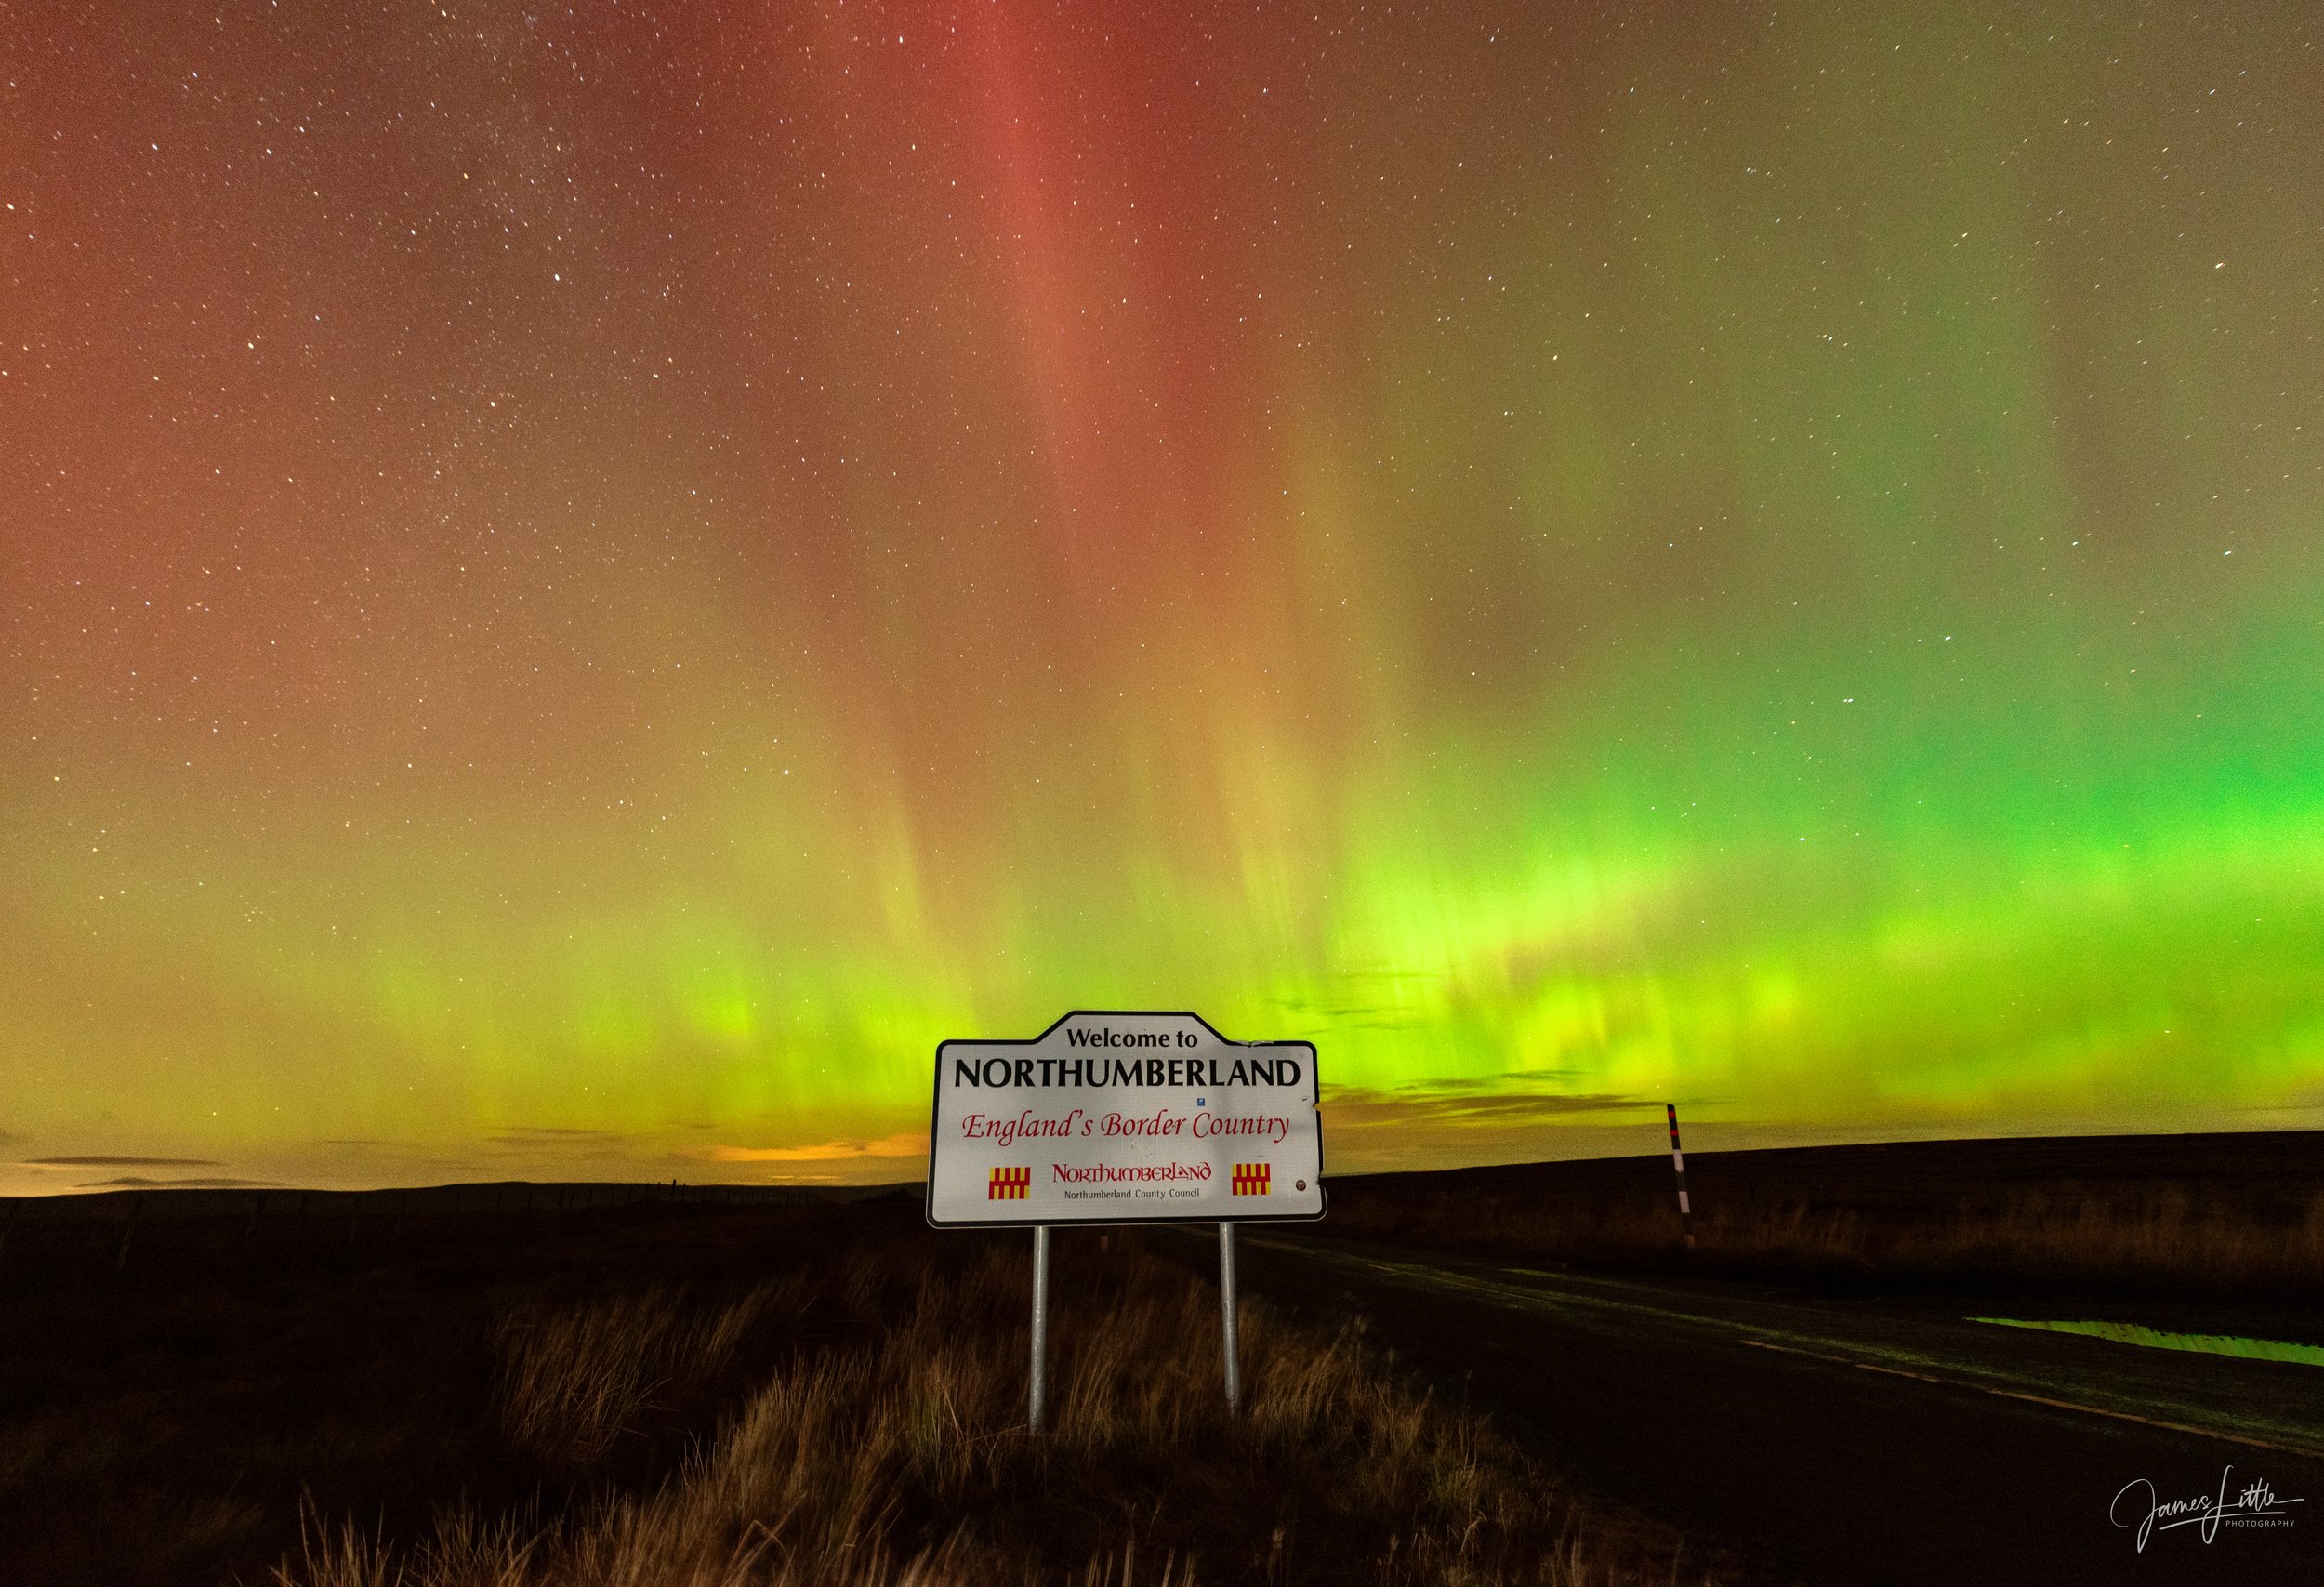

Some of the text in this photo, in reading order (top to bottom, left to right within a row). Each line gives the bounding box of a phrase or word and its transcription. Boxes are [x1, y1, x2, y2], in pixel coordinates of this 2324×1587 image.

[1067, 1028, 1198, 1048] Welcome to
[955, 1058, 1301, 1088] NORTHUMBERLAND
[962, 1109, 1289, 1146] England's Border Country
[1064, 1188, 1199, 1200] Northumberland County Council
